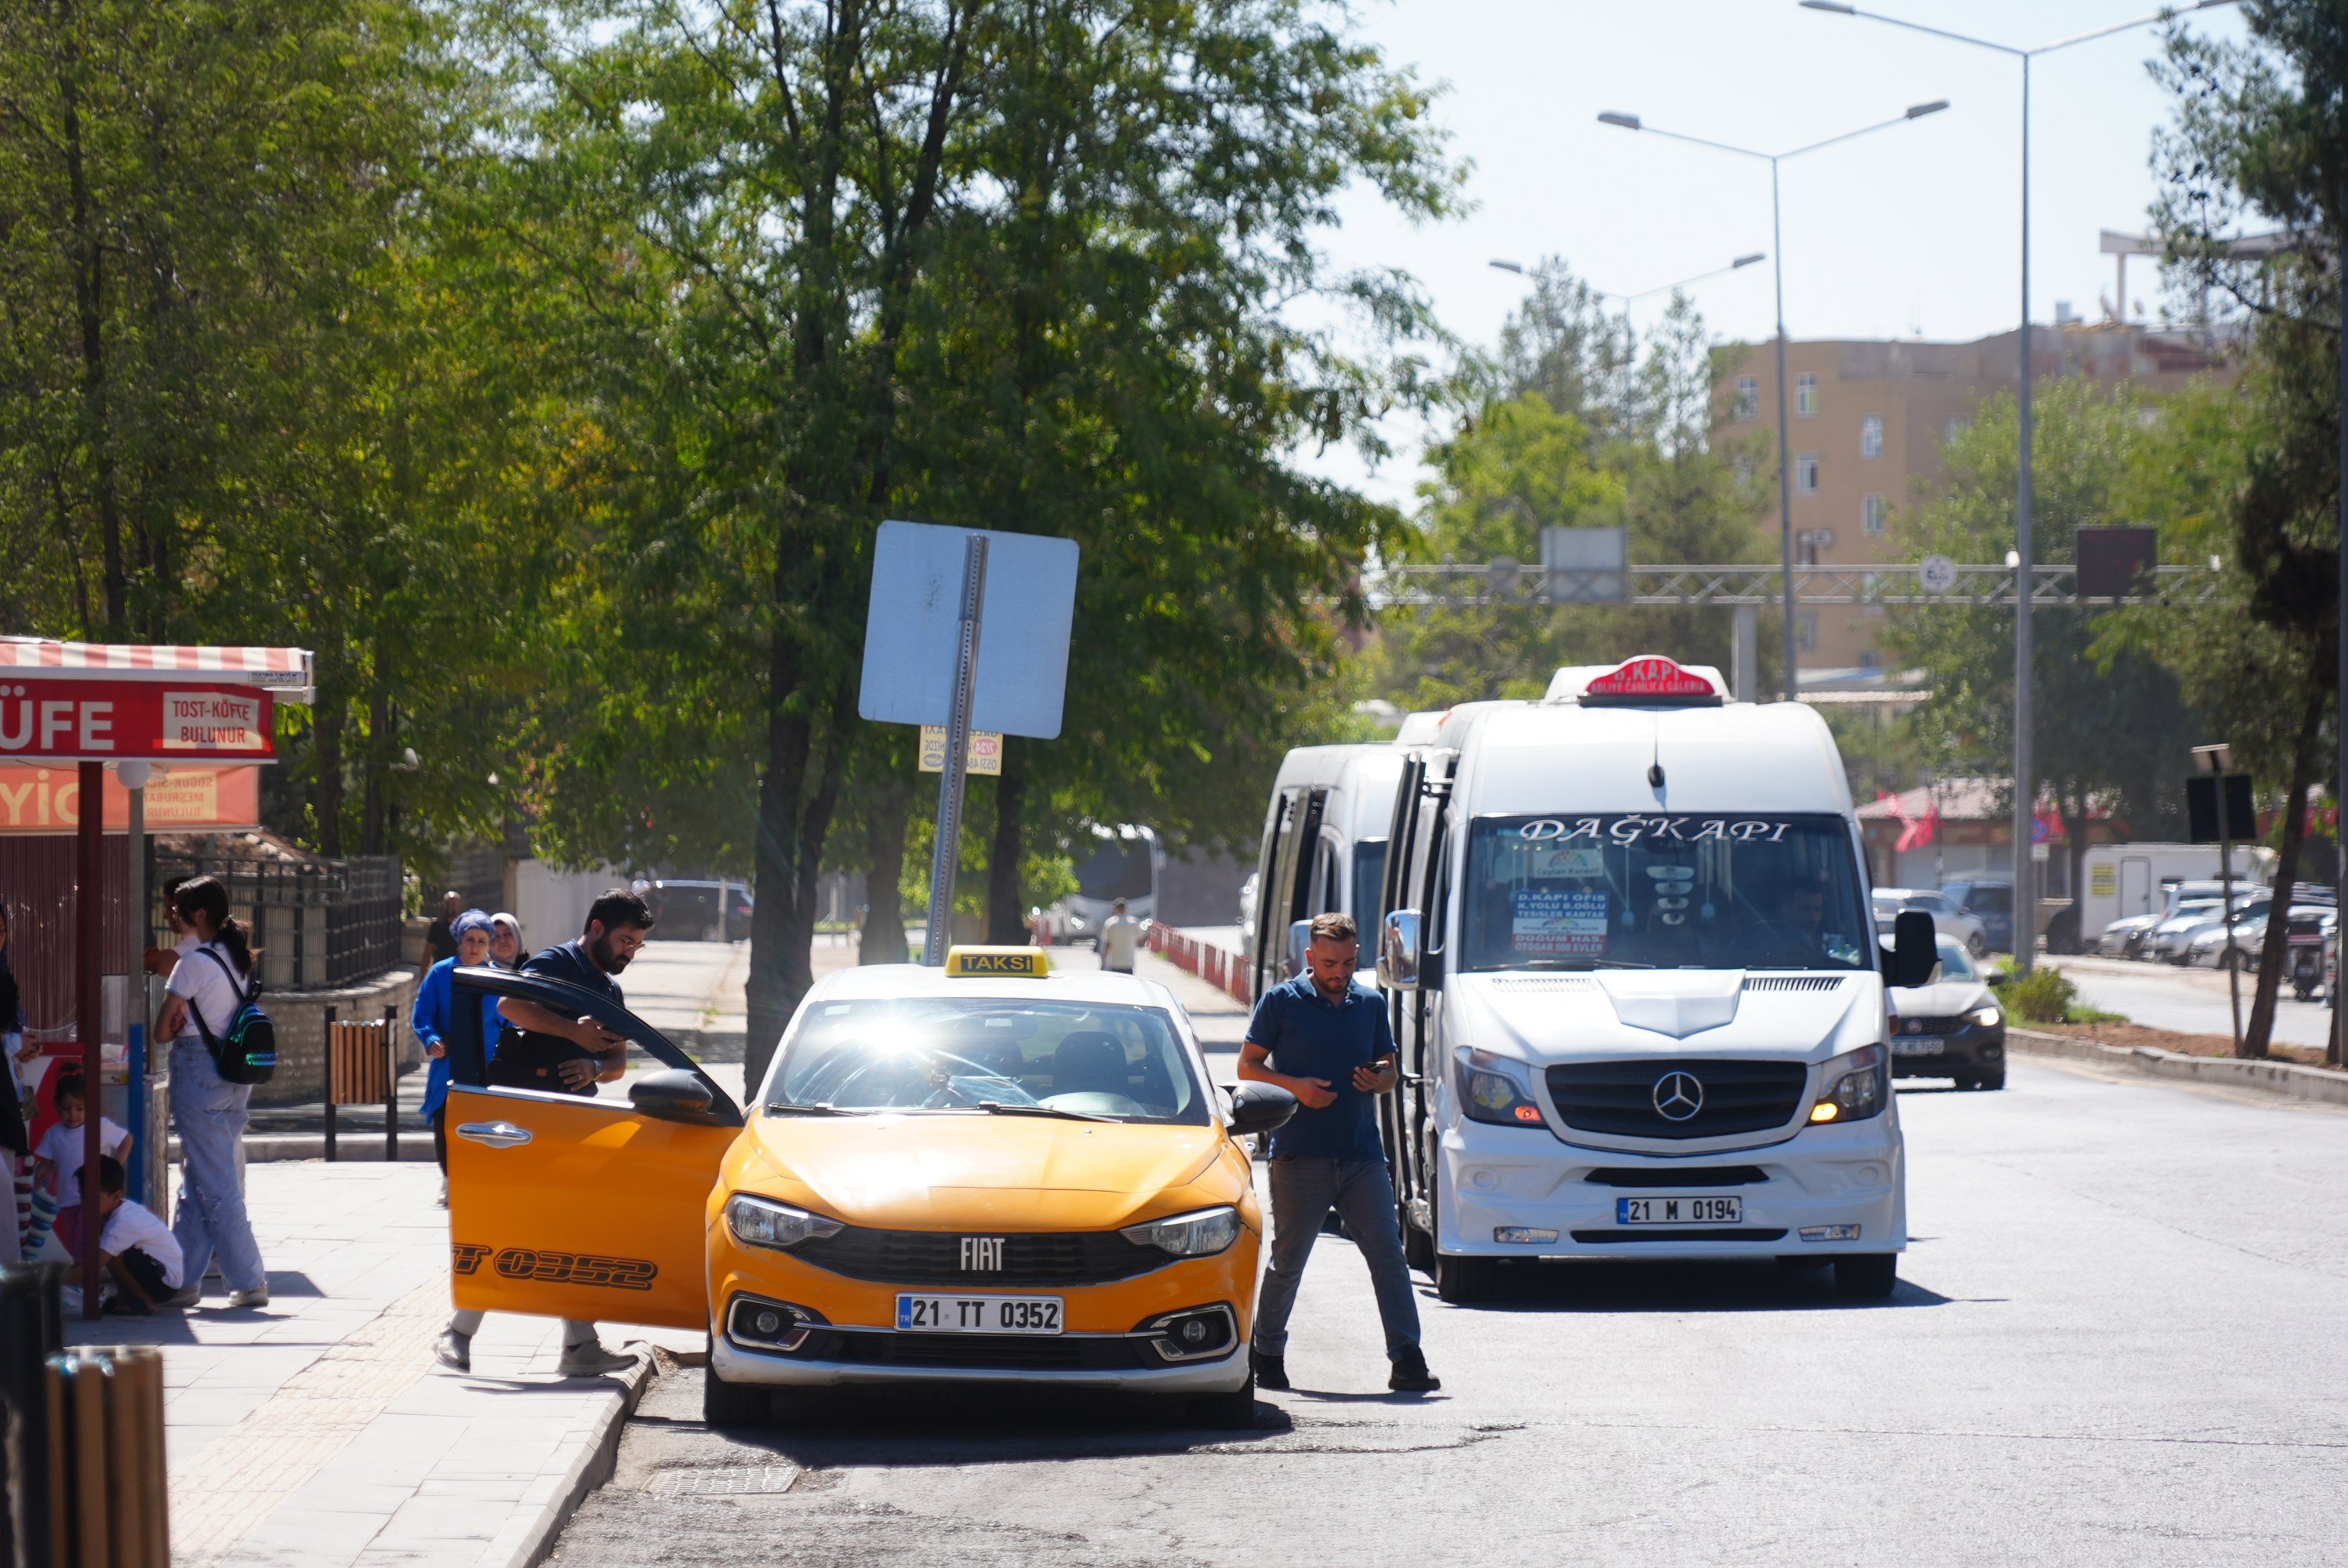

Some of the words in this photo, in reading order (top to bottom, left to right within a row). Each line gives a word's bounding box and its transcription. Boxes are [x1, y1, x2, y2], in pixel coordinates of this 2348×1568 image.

[172, 699, 249, 721] TOST-KÖFTE
[180, 726, 245, 743] BULUNUR
[1519, 814, 1792, 846] DAĞKAPI
[1630, 1201, 1650, 1221] 21
[1666, 1201, 1678, 1220] M
[1692, 1200, 1736, 1220] 0194
[961, 1237, 1005, 1271] FIAT
[493, 1247, 659, 1291] 0352
[912, 1300, 939, 1327] 21
[957, 1301, 984, 1327] TT
[1000, 1301, 1058, 1329] 0352
